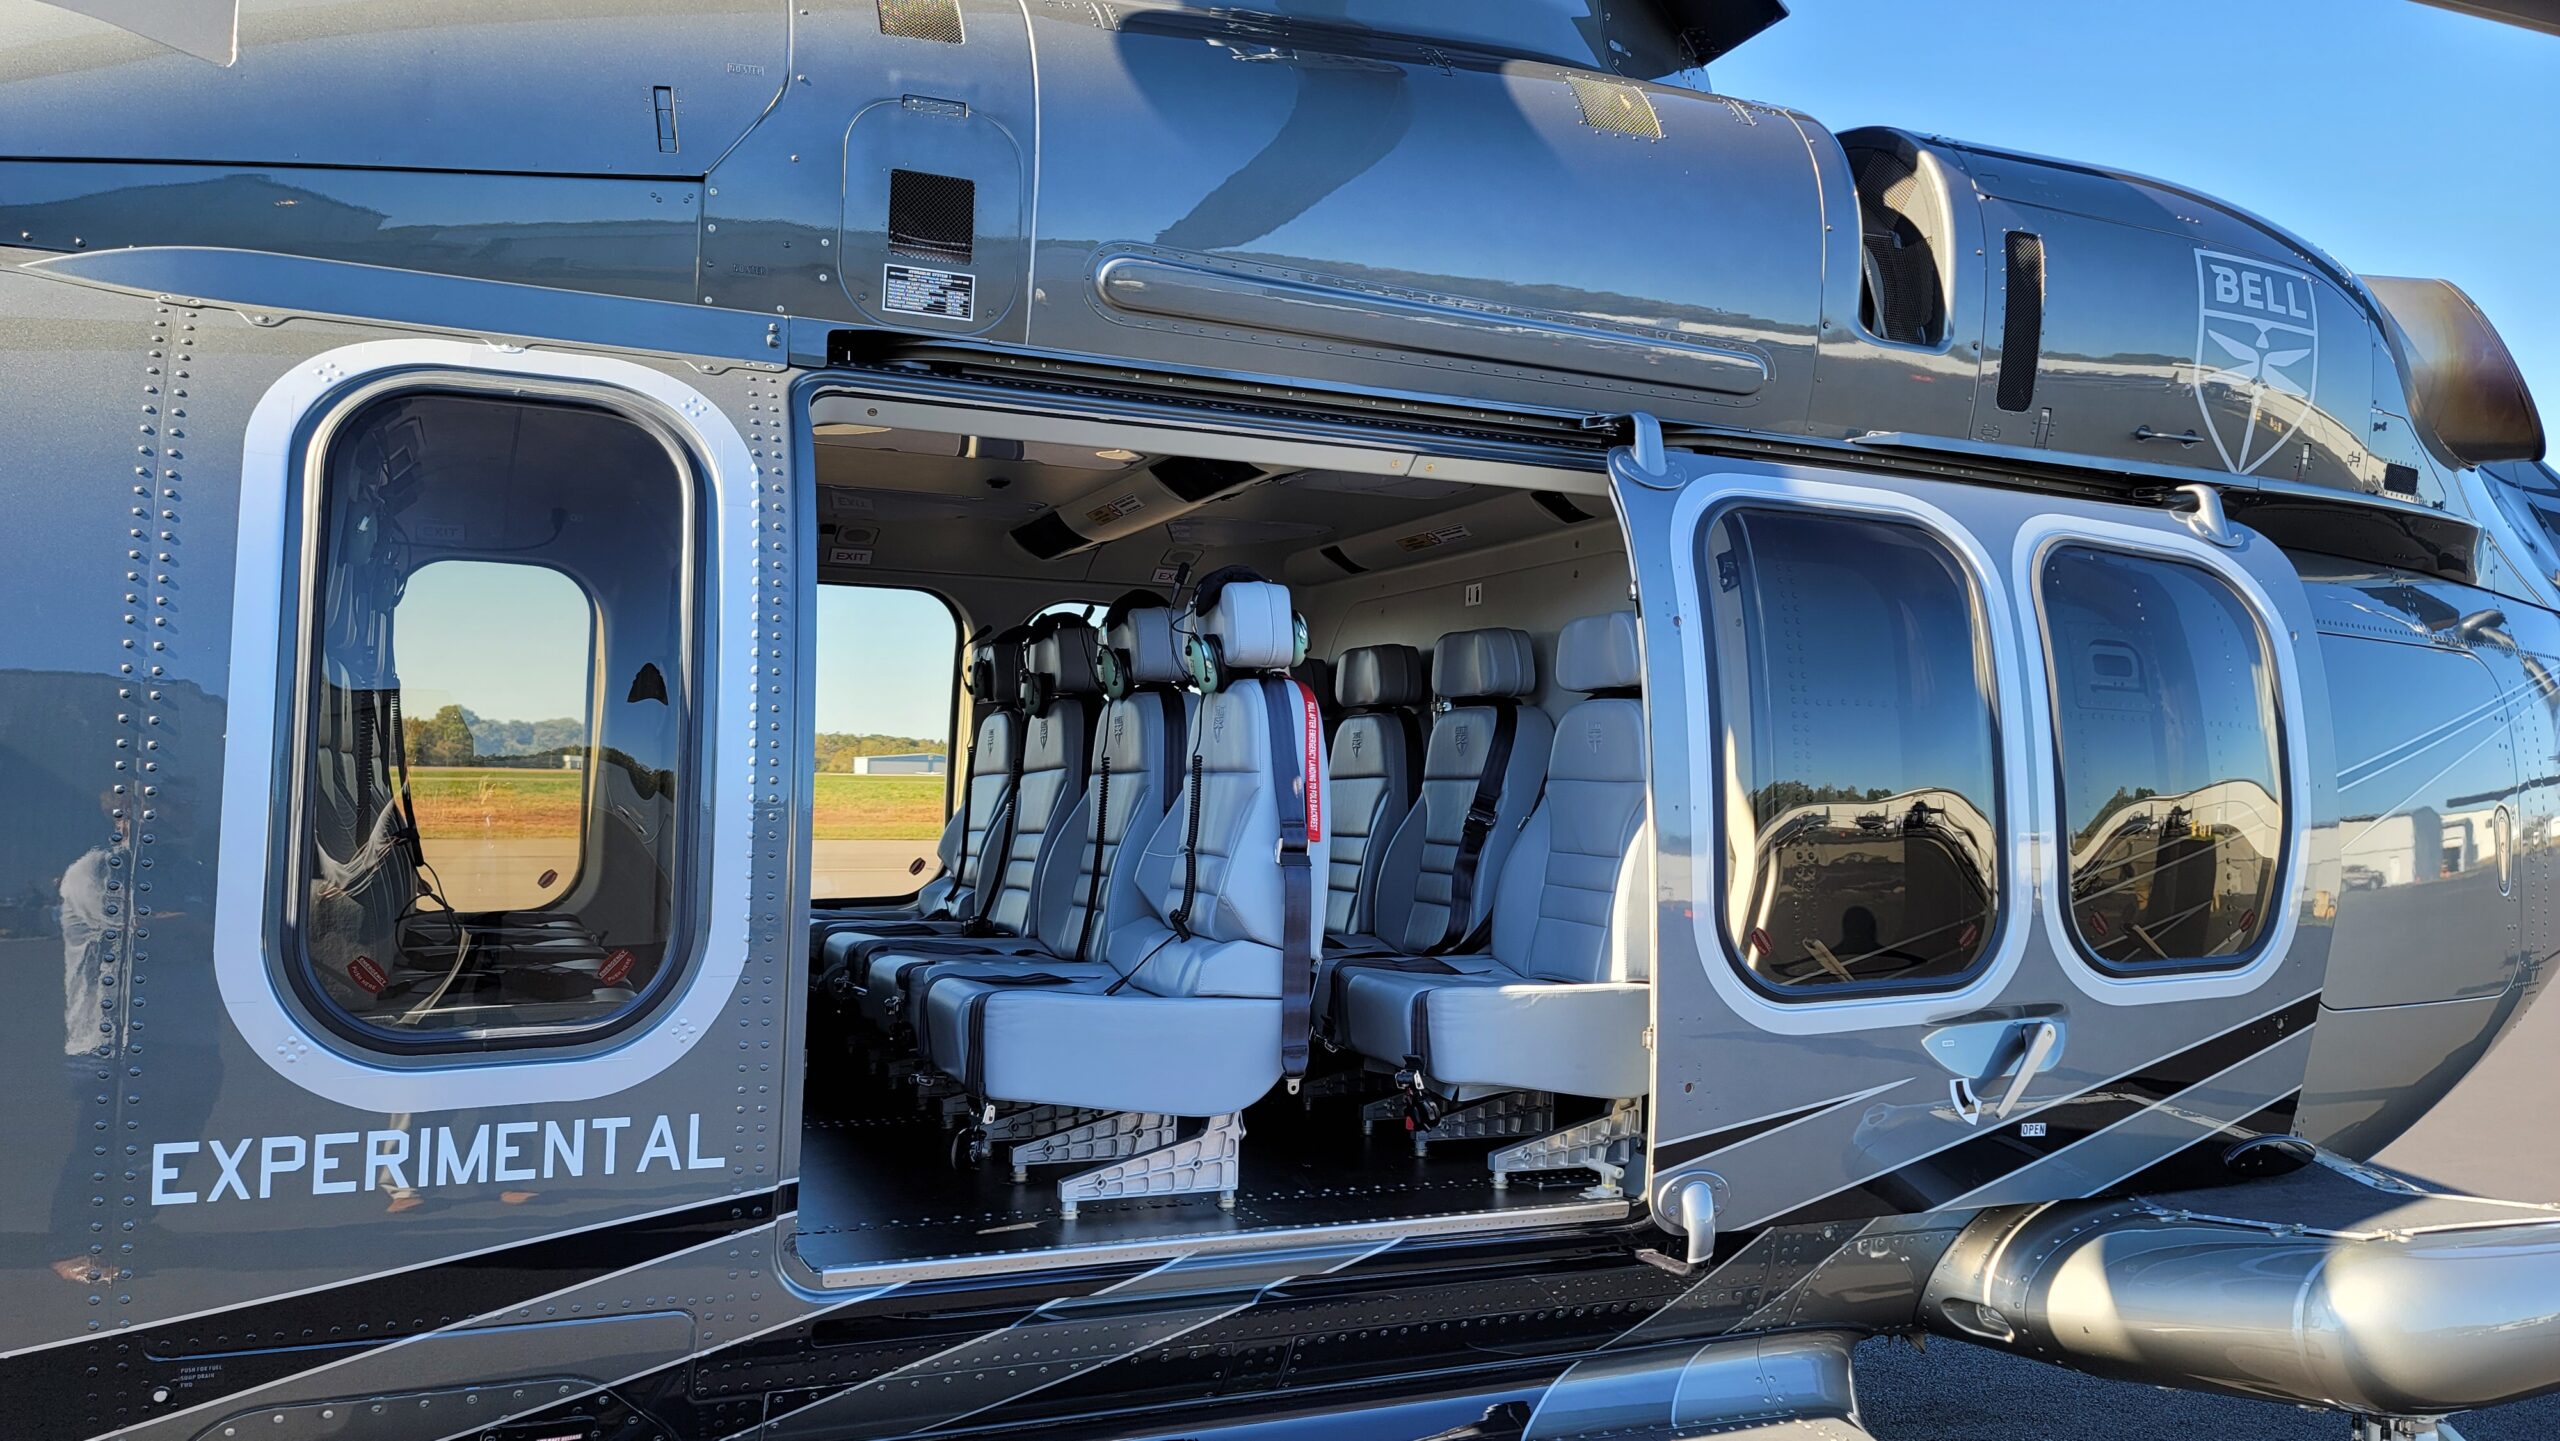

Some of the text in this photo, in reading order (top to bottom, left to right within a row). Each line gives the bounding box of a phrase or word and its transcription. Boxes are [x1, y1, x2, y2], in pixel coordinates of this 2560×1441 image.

[2209, 264, 2307, 319] BELL
[836, 552, 867, 561] EXIT
[1308, 713, 1316, 729] AFTER
[1308, 729, 1317, 760] EMERGENCY
[1308, 760, 1317, 782] LANDING
[1309, 790, 1317, 803] FOLD
[359, 957, 387, 985] EMERGENCY
[599, 950, 626, 977] EMERGENCY
[2022, 1124, 2045, 1136] OPEN
[151, 1114, 726, 1206] EXPERIMENTAL
